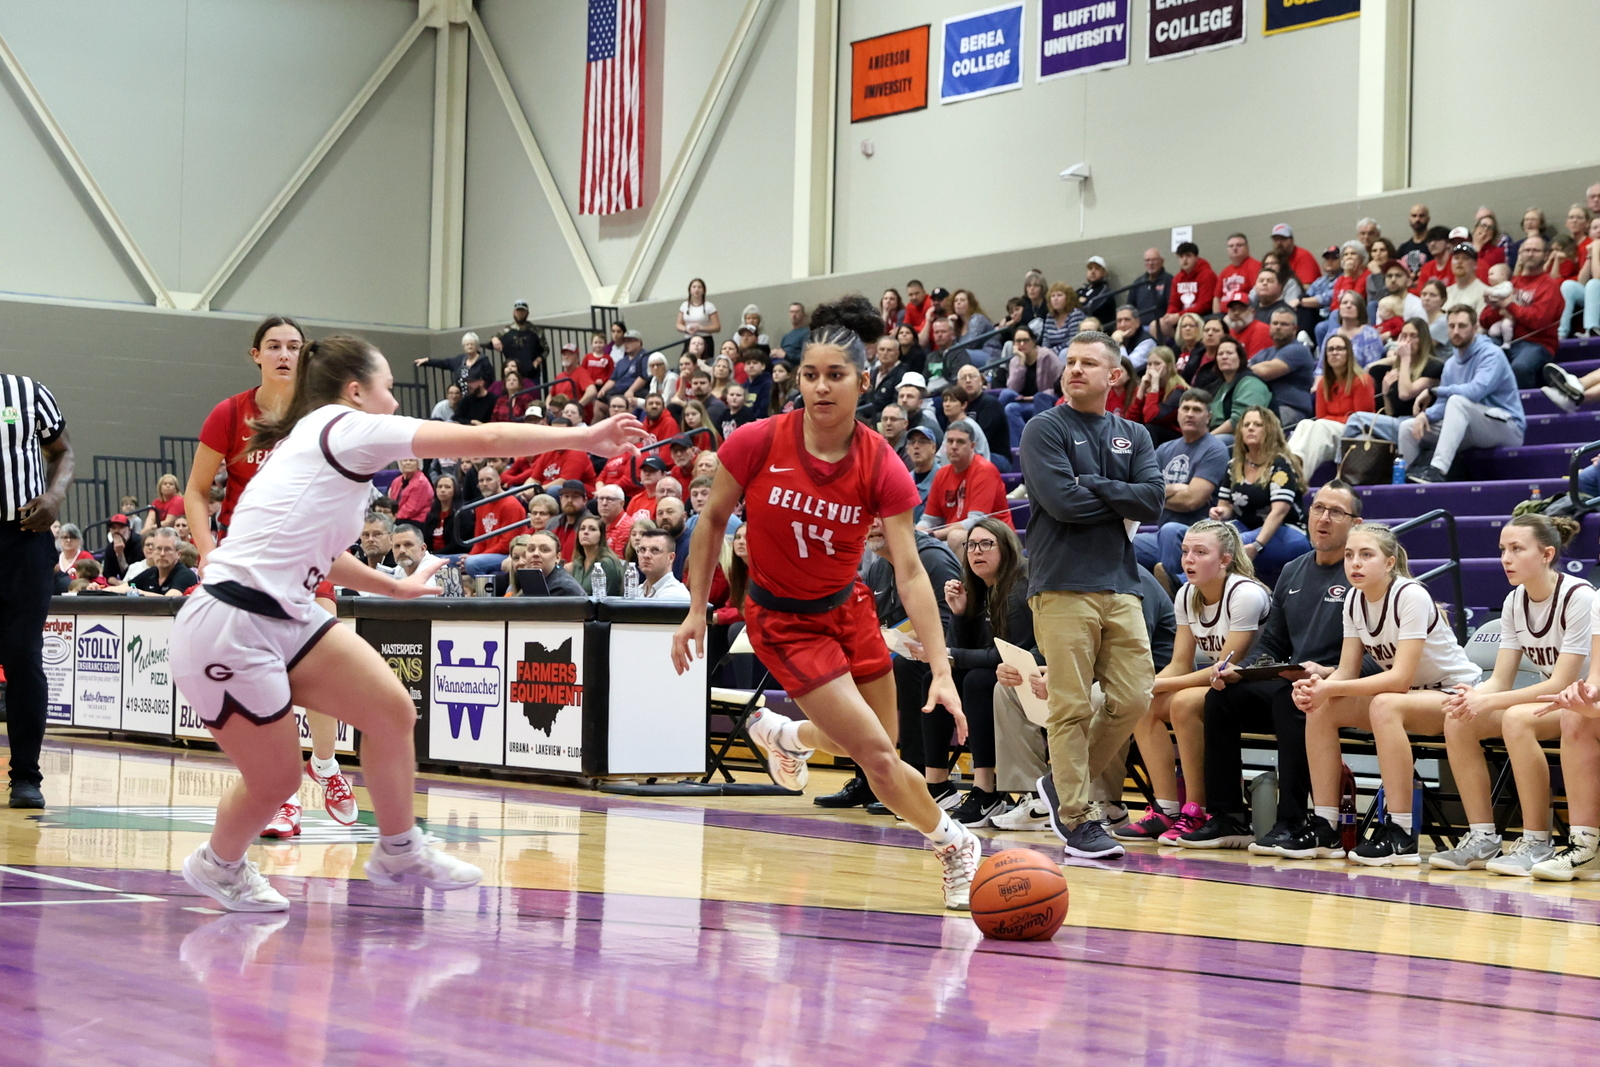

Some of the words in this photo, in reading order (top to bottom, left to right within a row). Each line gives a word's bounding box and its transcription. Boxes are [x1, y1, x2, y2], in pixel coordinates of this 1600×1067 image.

[1052, 0, 1117, 31] BLUFFTON
[1155, 5, 1233, 42] COLLEGE
[960, 28, 1005, 54] BEREA
[1044, 23, 1125, 57] UNIVERSITY
[868, 48, 910, 71] ANDERSON
[952, 48, 1011, 78] COLLEGE
[864, 77, 912, 99] UNIVERSITY
[1112, 437, 1132, 450] G
[768, 486, 862, 524] BELLEVUE
[791, 521, 835, 558] 14
[43, 618, 73, 636] erdyne
[78, 637, 120, 659] STOLLY
[381, 643, 423, 655] MASTERPIECE
[1474, 634, 1501, 643] BLU
[77, 661, 103, 672] INSURANCE
[103, 662, 120, 673] GROUP
[204, 663, 235, 682] G
[517, 661, 577, 684] FARMERS
[150, 672, 168, 686] PIZZA
[436, 675, 498, 695] Wannemacher
[80, 689, 116, 703] Auto-Owners
[510, 681, 583, 707] EQUIPMENT
[126, 697, 170, 715] 419-358-0825
[179, 705, 207, 729] BLU
[509, 742, 530, 754] URBANA
[535, 743, 561, 757] LAKEVIEW
[1000, 881, 1029, 895] OHSAA
[991, 906, 1053, 937] Rawlings
